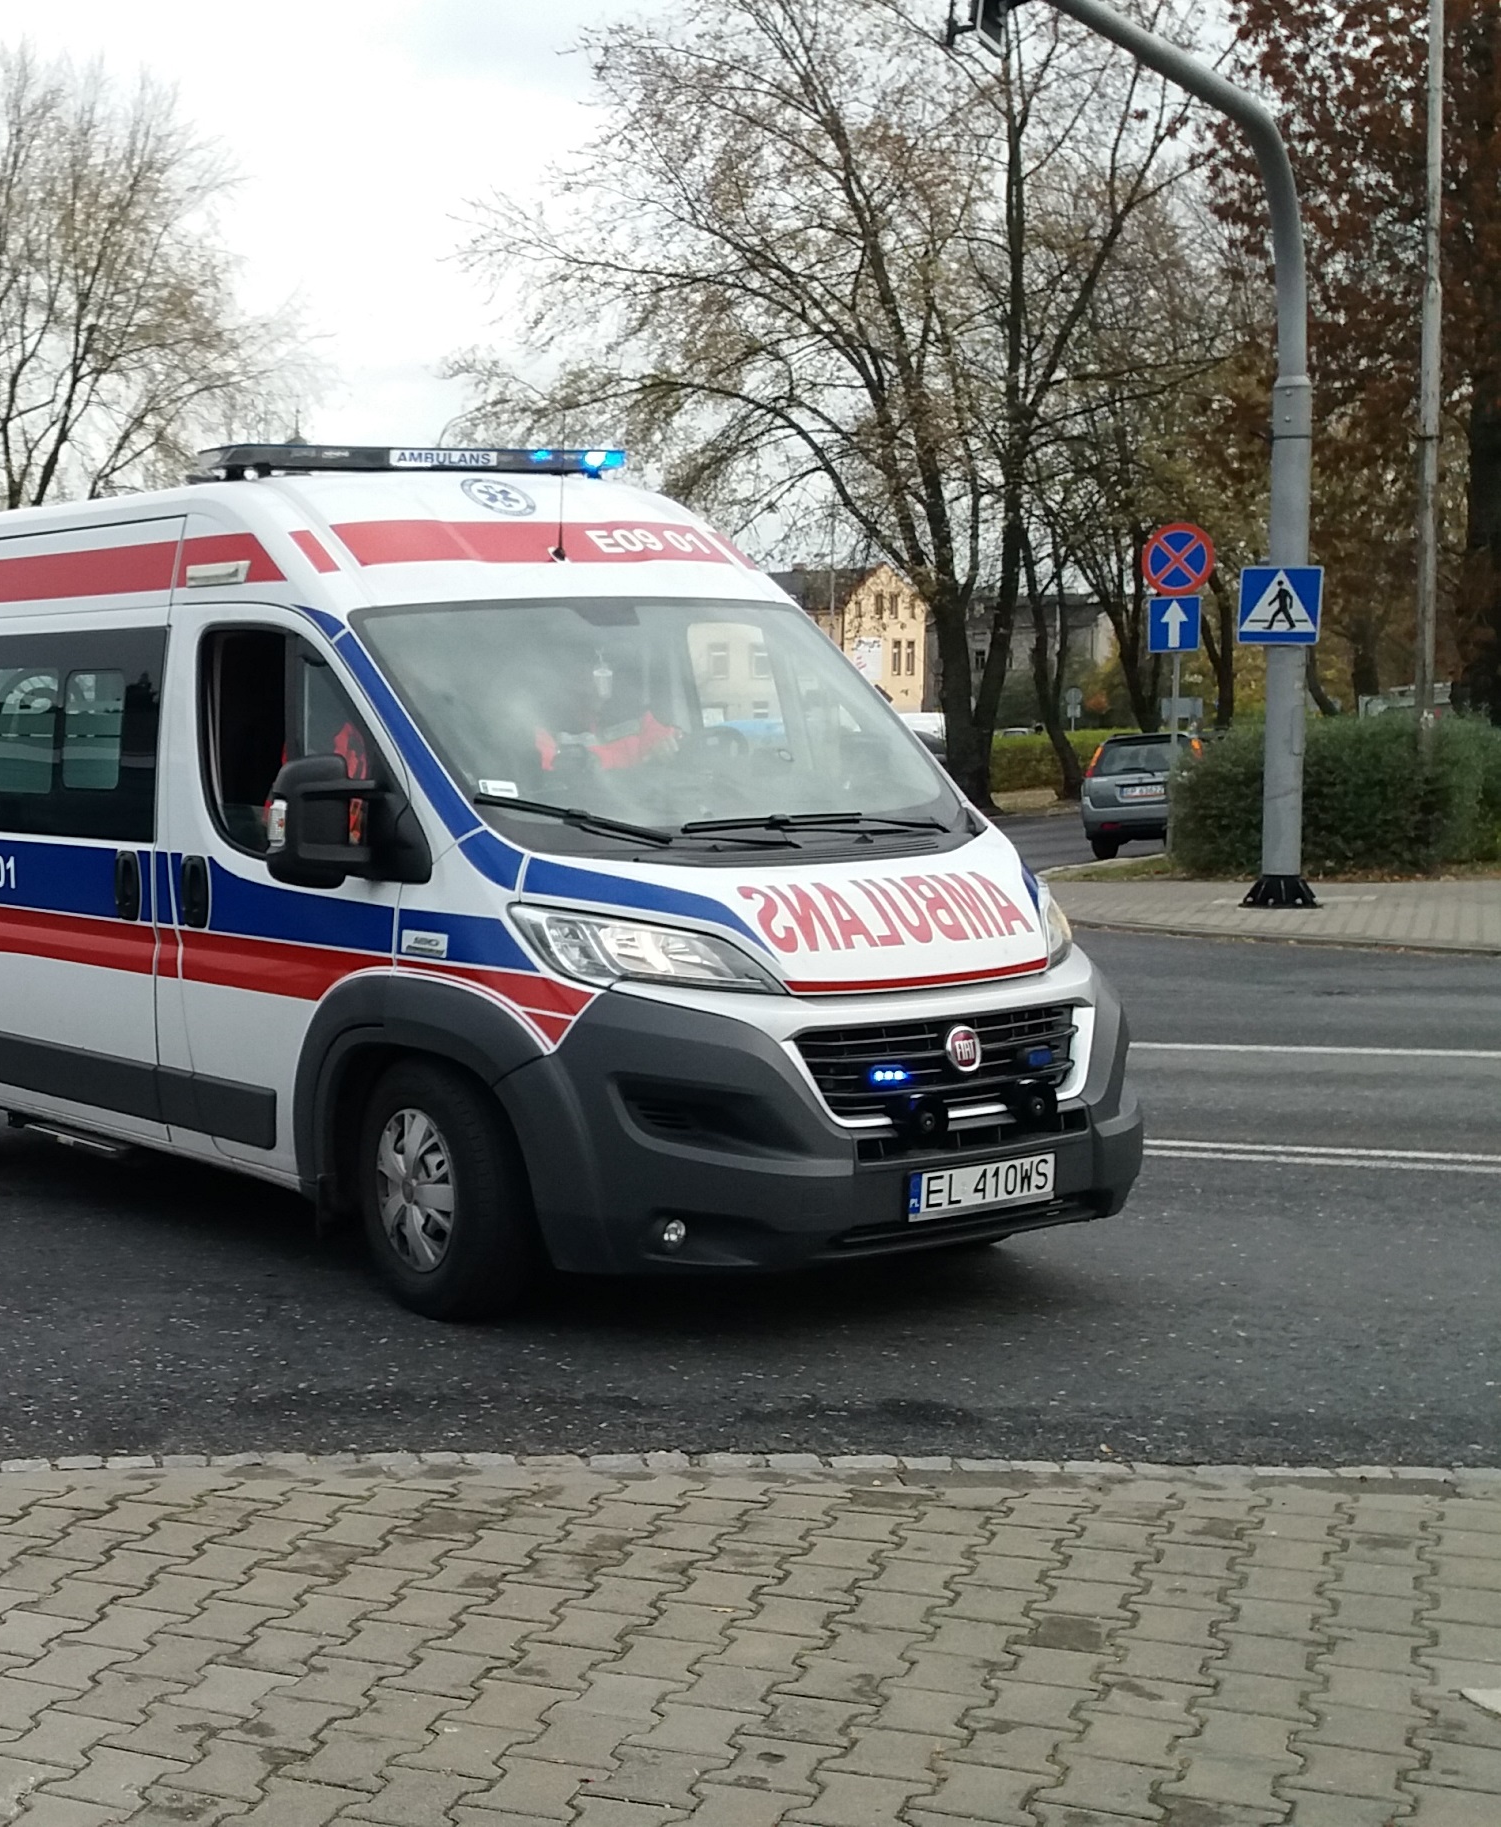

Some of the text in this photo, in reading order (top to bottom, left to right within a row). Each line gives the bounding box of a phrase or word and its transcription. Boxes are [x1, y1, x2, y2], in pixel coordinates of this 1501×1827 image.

[397, 452, 491, 465] AMBULANS
[584, 528, 711, 554] E09 01
[954, 1038, 975, 1061] FIAT
[925, 1158, 1049, 1208] EL 410WS
[909, 1198, 920, 1208] PL
